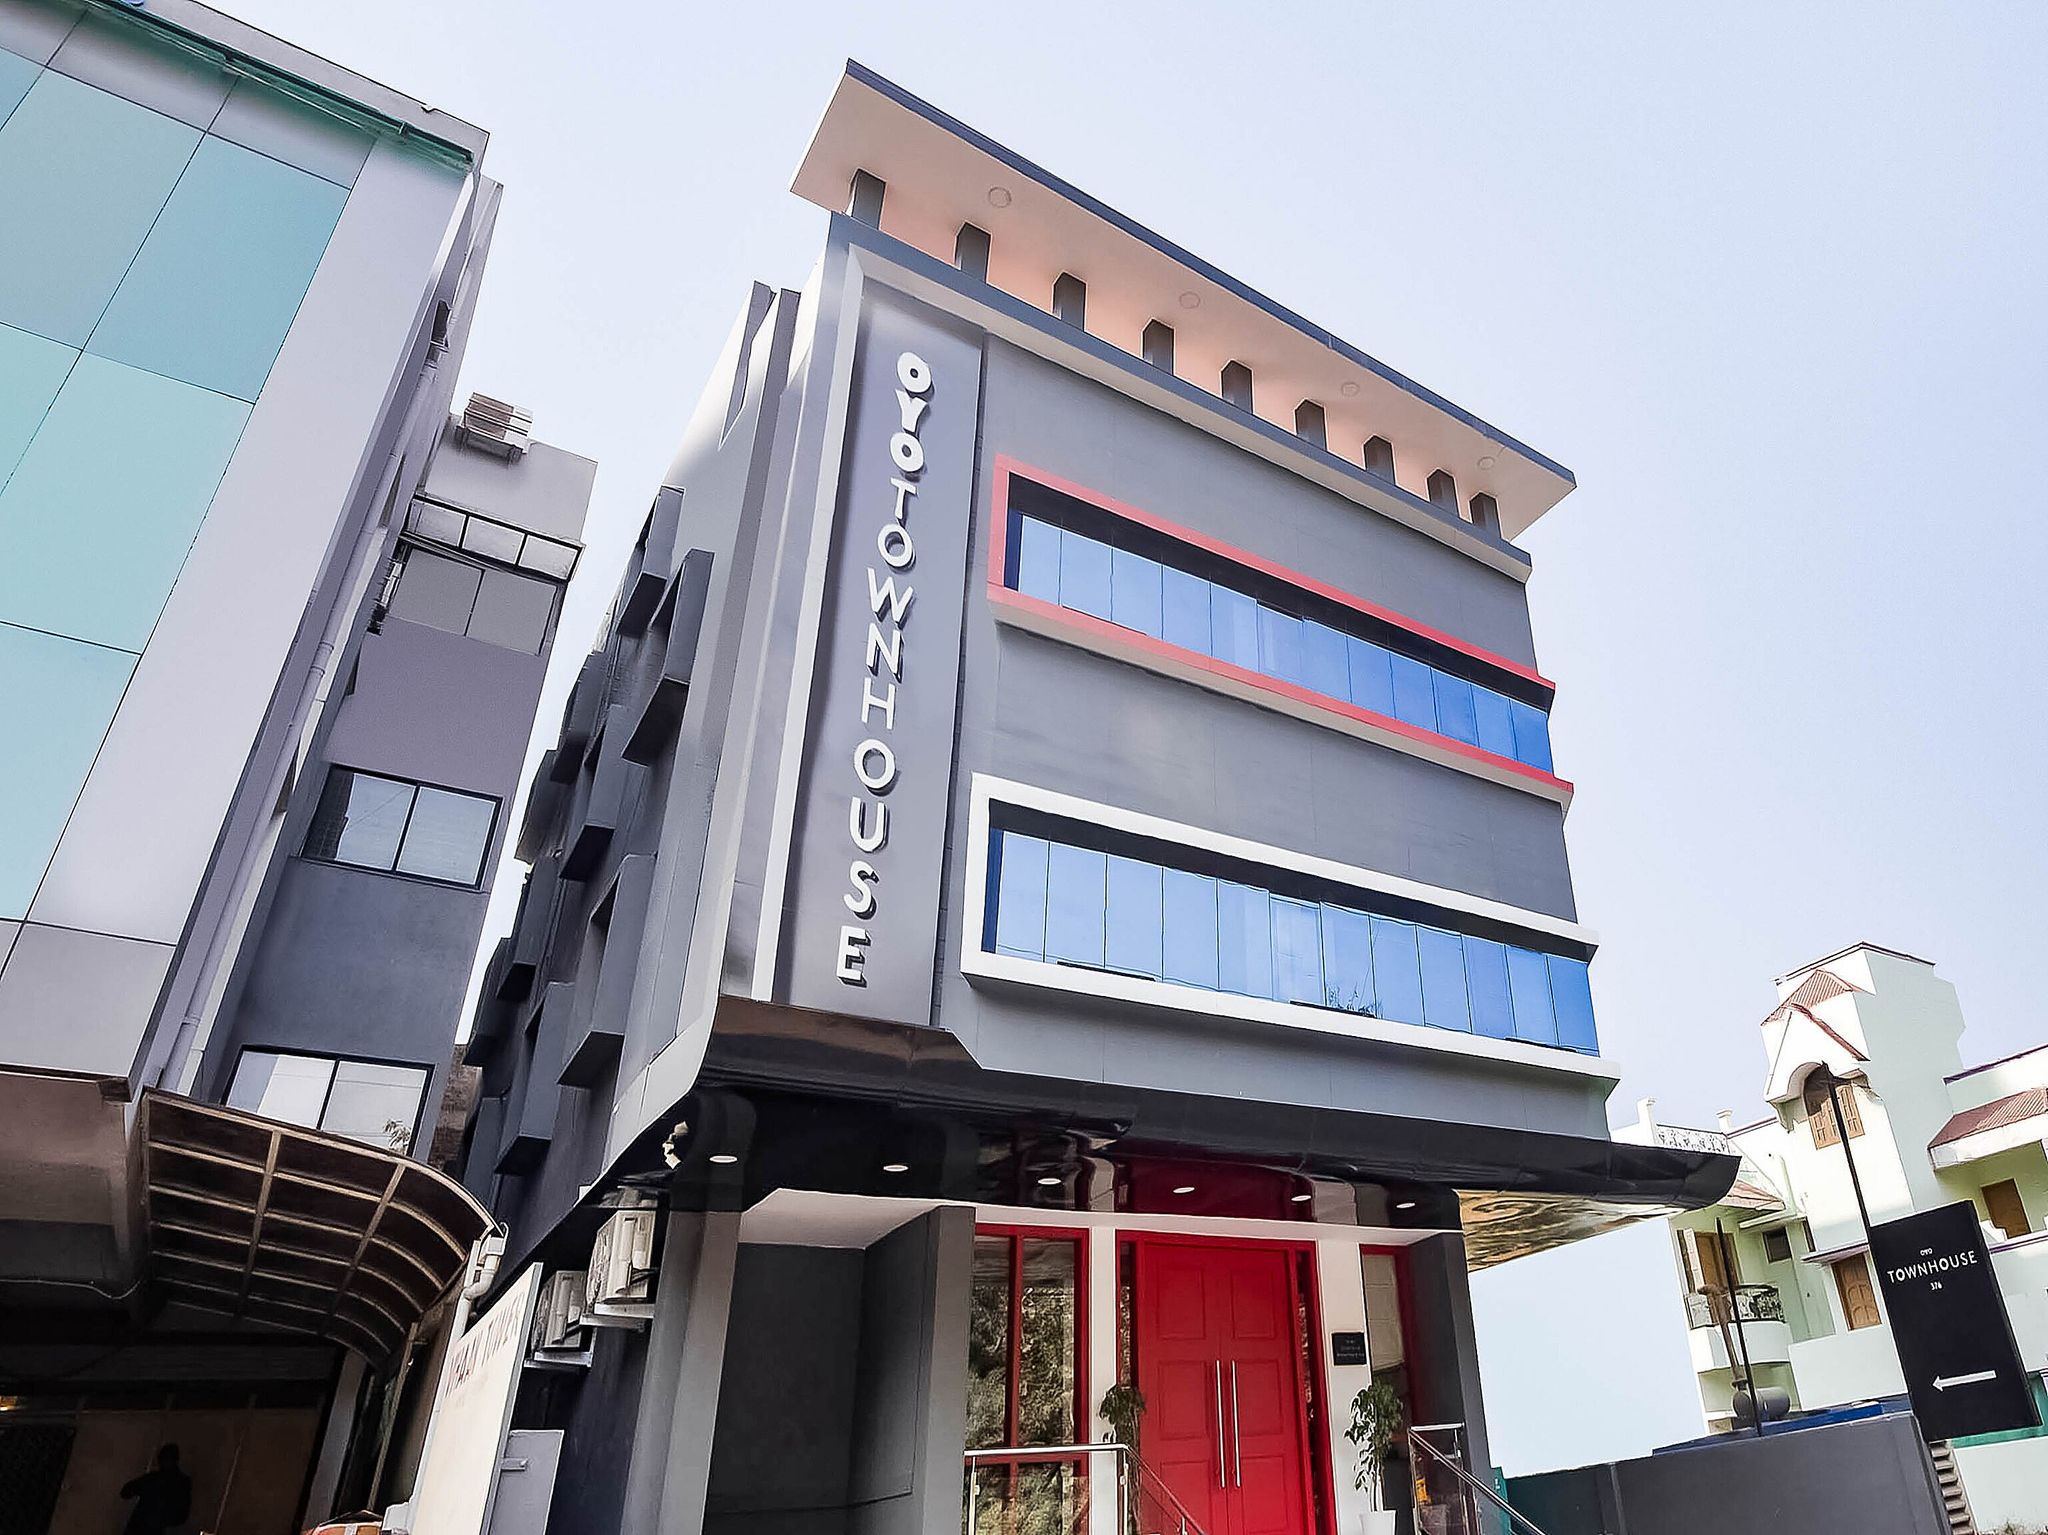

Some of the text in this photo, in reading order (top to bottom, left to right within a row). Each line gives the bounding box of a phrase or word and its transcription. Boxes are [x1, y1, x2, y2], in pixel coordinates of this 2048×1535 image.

[836, 352, 932, 983] OYO TOWNHOUSE
[1886, 1250, 1978, 1284] TOWNHOUSE
